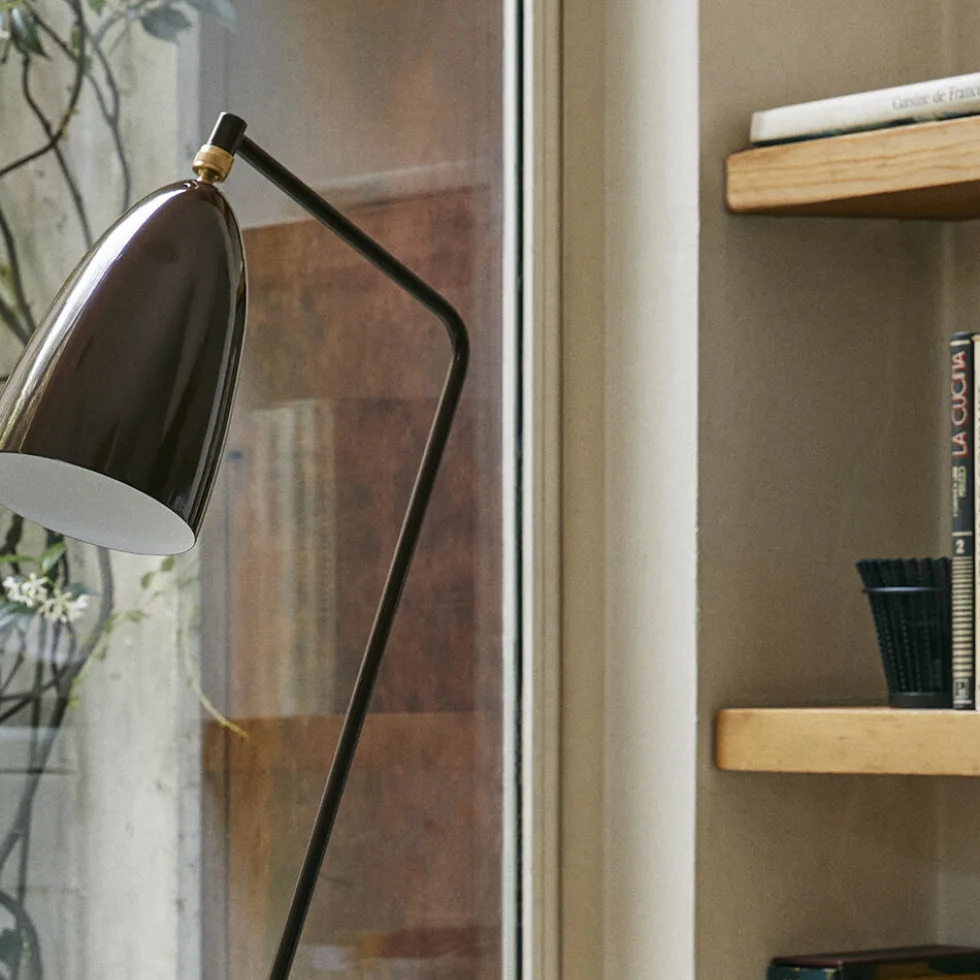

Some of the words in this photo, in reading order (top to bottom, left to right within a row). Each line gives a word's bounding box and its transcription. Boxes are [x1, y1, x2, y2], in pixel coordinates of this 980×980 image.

[932, 89, 946, 104] de
[951, 350, 970, 428] CUCINA
[951, 431, 969, 458] LA
[955, 538, 965, 555] 2
